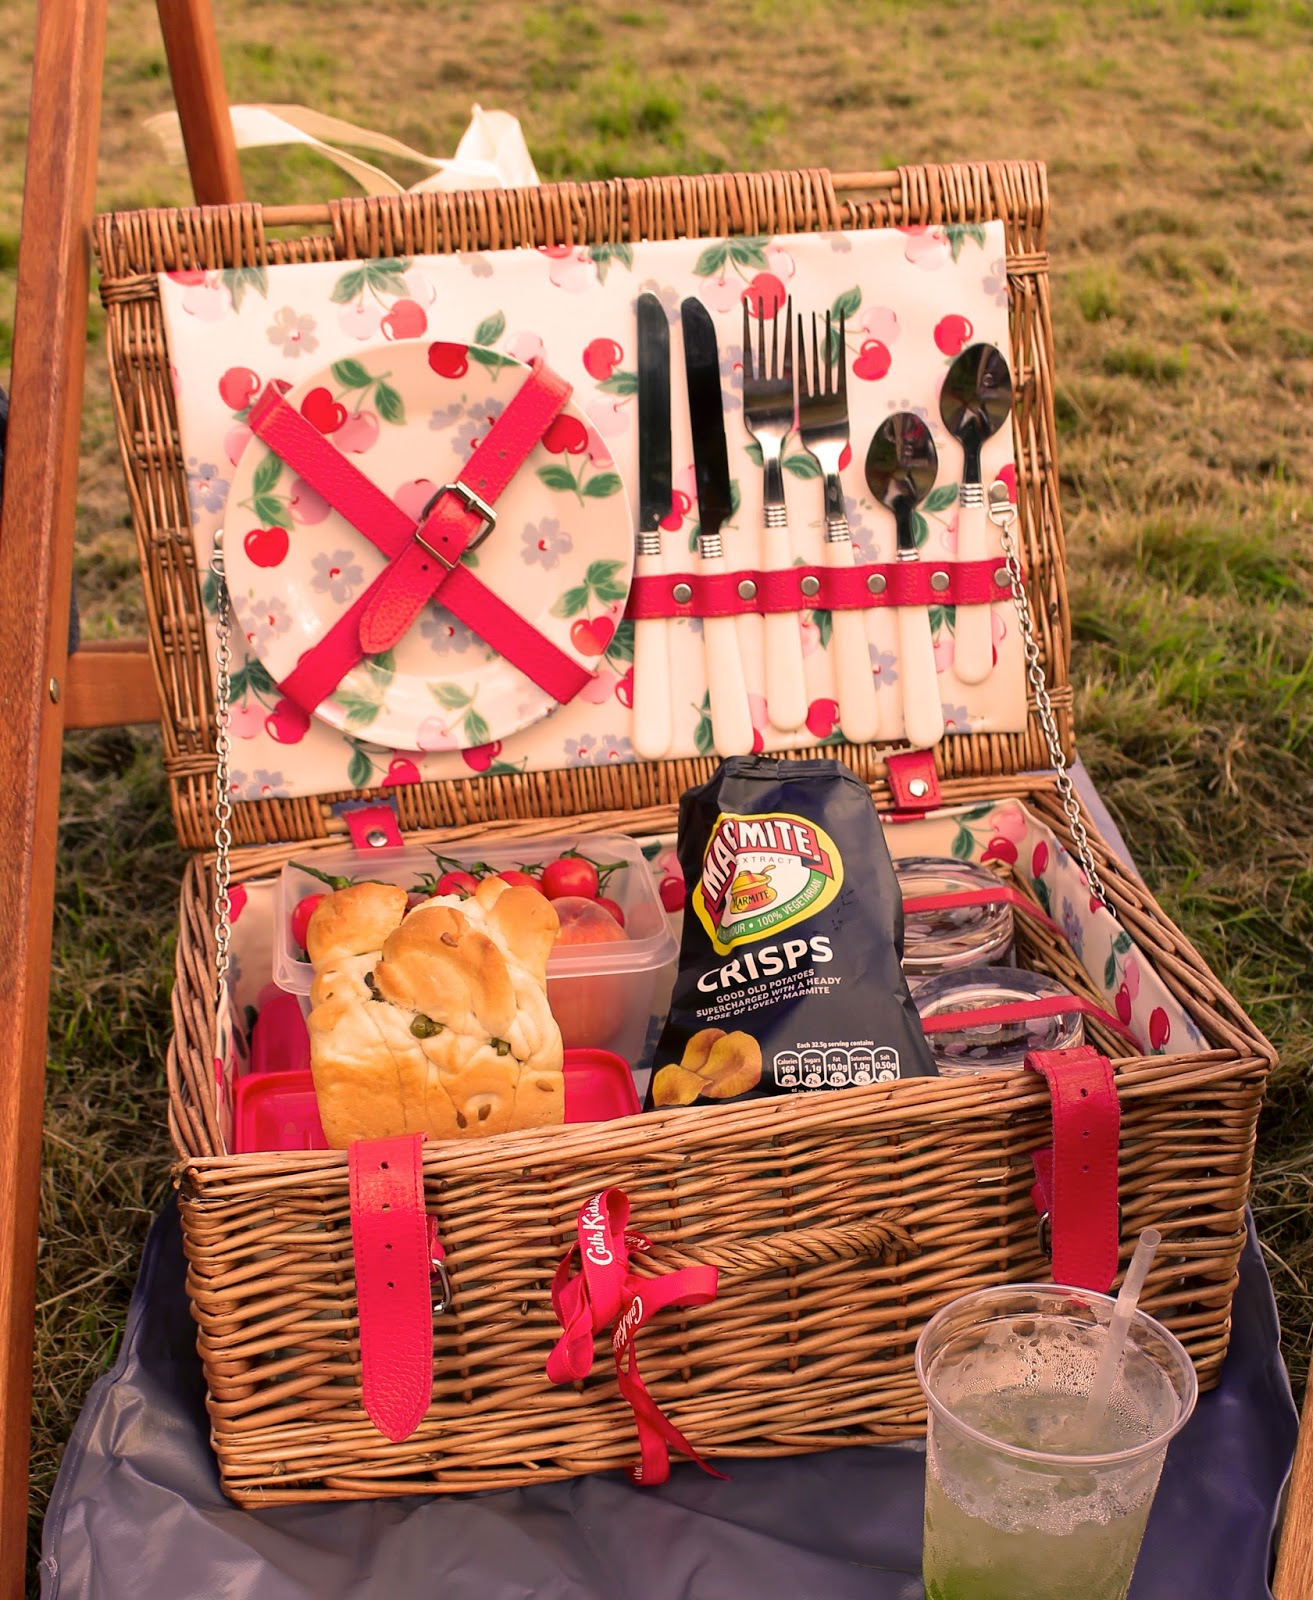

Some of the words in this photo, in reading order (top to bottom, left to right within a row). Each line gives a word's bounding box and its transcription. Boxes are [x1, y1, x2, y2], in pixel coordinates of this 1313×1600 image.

[736, 855, 792, 866] EXTRACT
[757, 911, 782, 927] 100%
[782, 879, 821, 914] VEGETARIAN
[697, 936, 833, 993] CRISPS
[696, 992, 770, 1018] SUPERCHARGED
[771, 984, 795, 996] WITH
[797, 981, 804, 989] A
[806, 977, 842, 985] HEADY
[716, 990, 745, 1003] GOOD
[748, 984, 767, 995] OLD
[769, 969, 815, 989] POTATOES
[706, 1012, 731, 1022] DOSE
[733, 1008, 746, 1016] OF
[747, 996, 781, 1011] LOVELY
[783, 986, 830, 1000] MARMITE
[781, 1065, 795, 1074] 169
[804, 1065, 822, 1074] 1.1g
[827, 1063, 848, 1073] 10.0g
[854, 1062, 870, 1071] 1.0g
[875, 1062, 896, 1070] 0.50g
[586, 1231, 613, 1266] Cath
[625, 1296, 643, 1329] Cath
